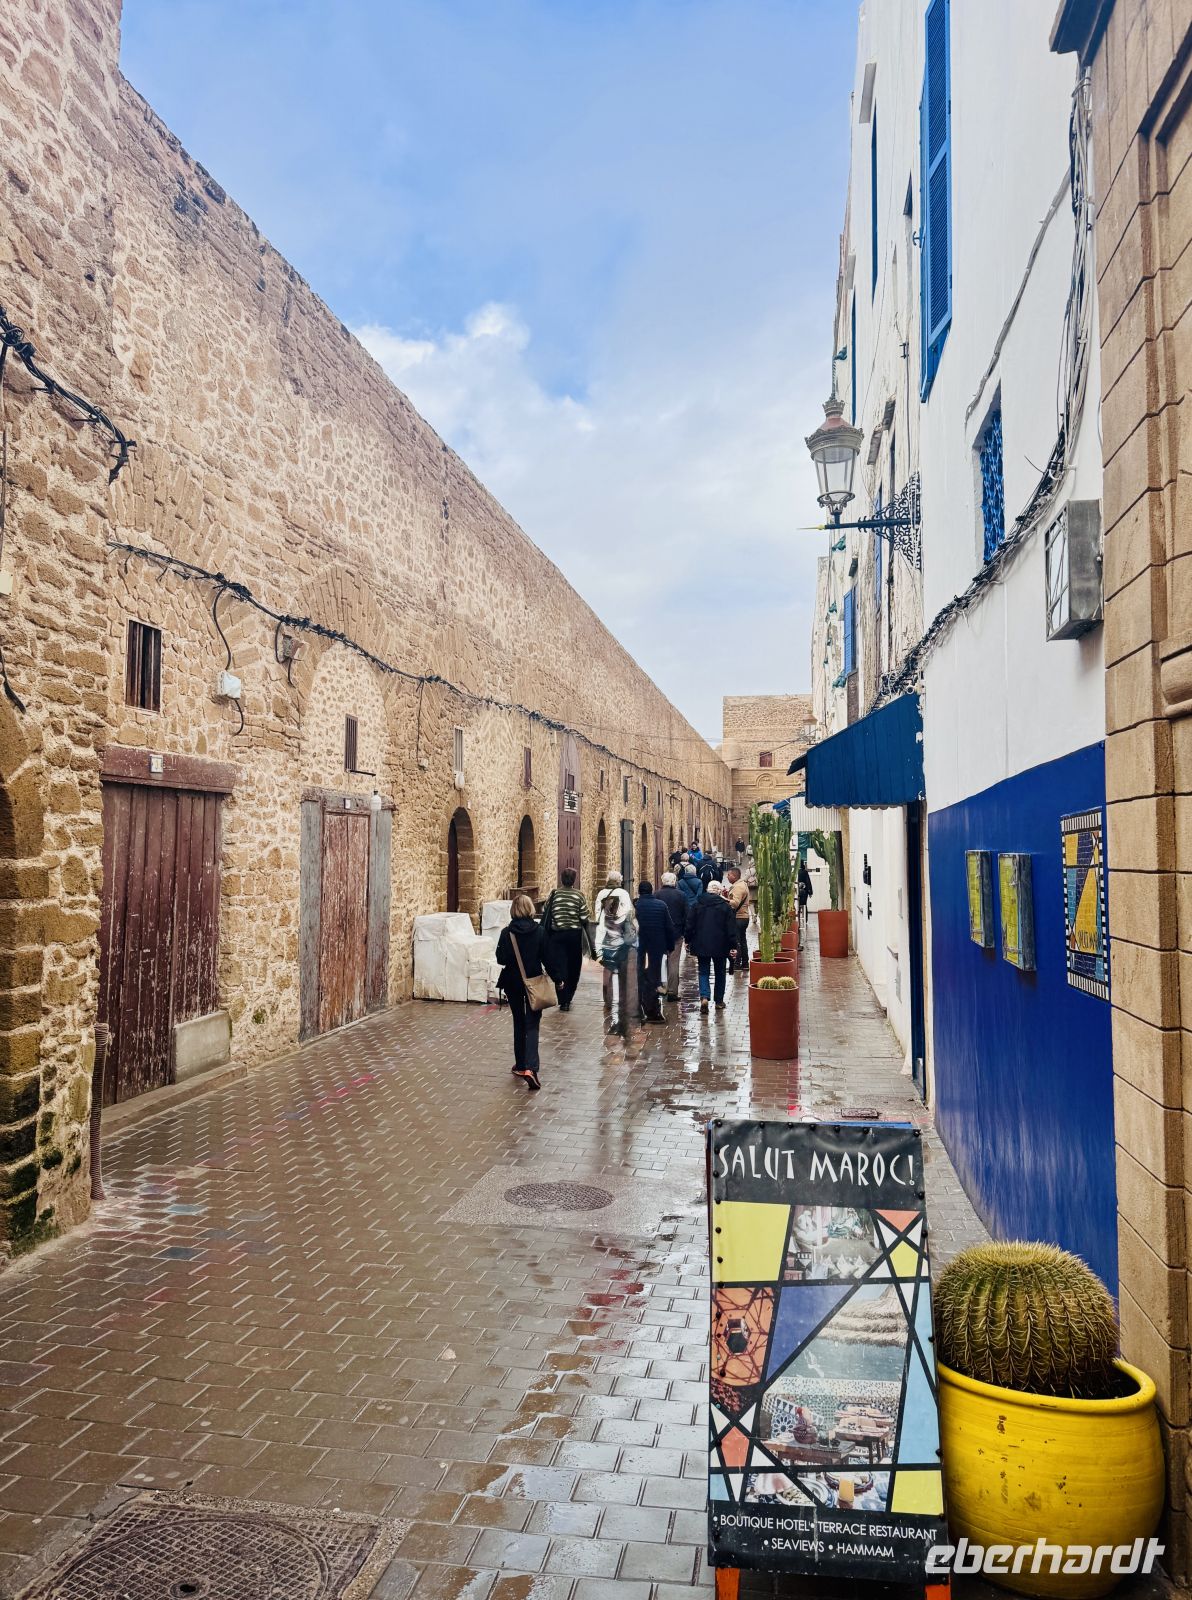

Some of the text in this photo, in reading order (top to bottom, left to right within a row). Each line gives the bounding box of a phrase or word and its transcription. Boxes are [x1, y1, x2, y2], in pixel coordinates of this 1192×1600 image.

[718, 1144, 915, 1188] SALUT MAROC!
[720, 1514, 938, 1541] BOUTIQUE HOTEL TERRACE RESTAURANT
[771, 1537, 895, 1558] SEAVIEWS HAMMAM
